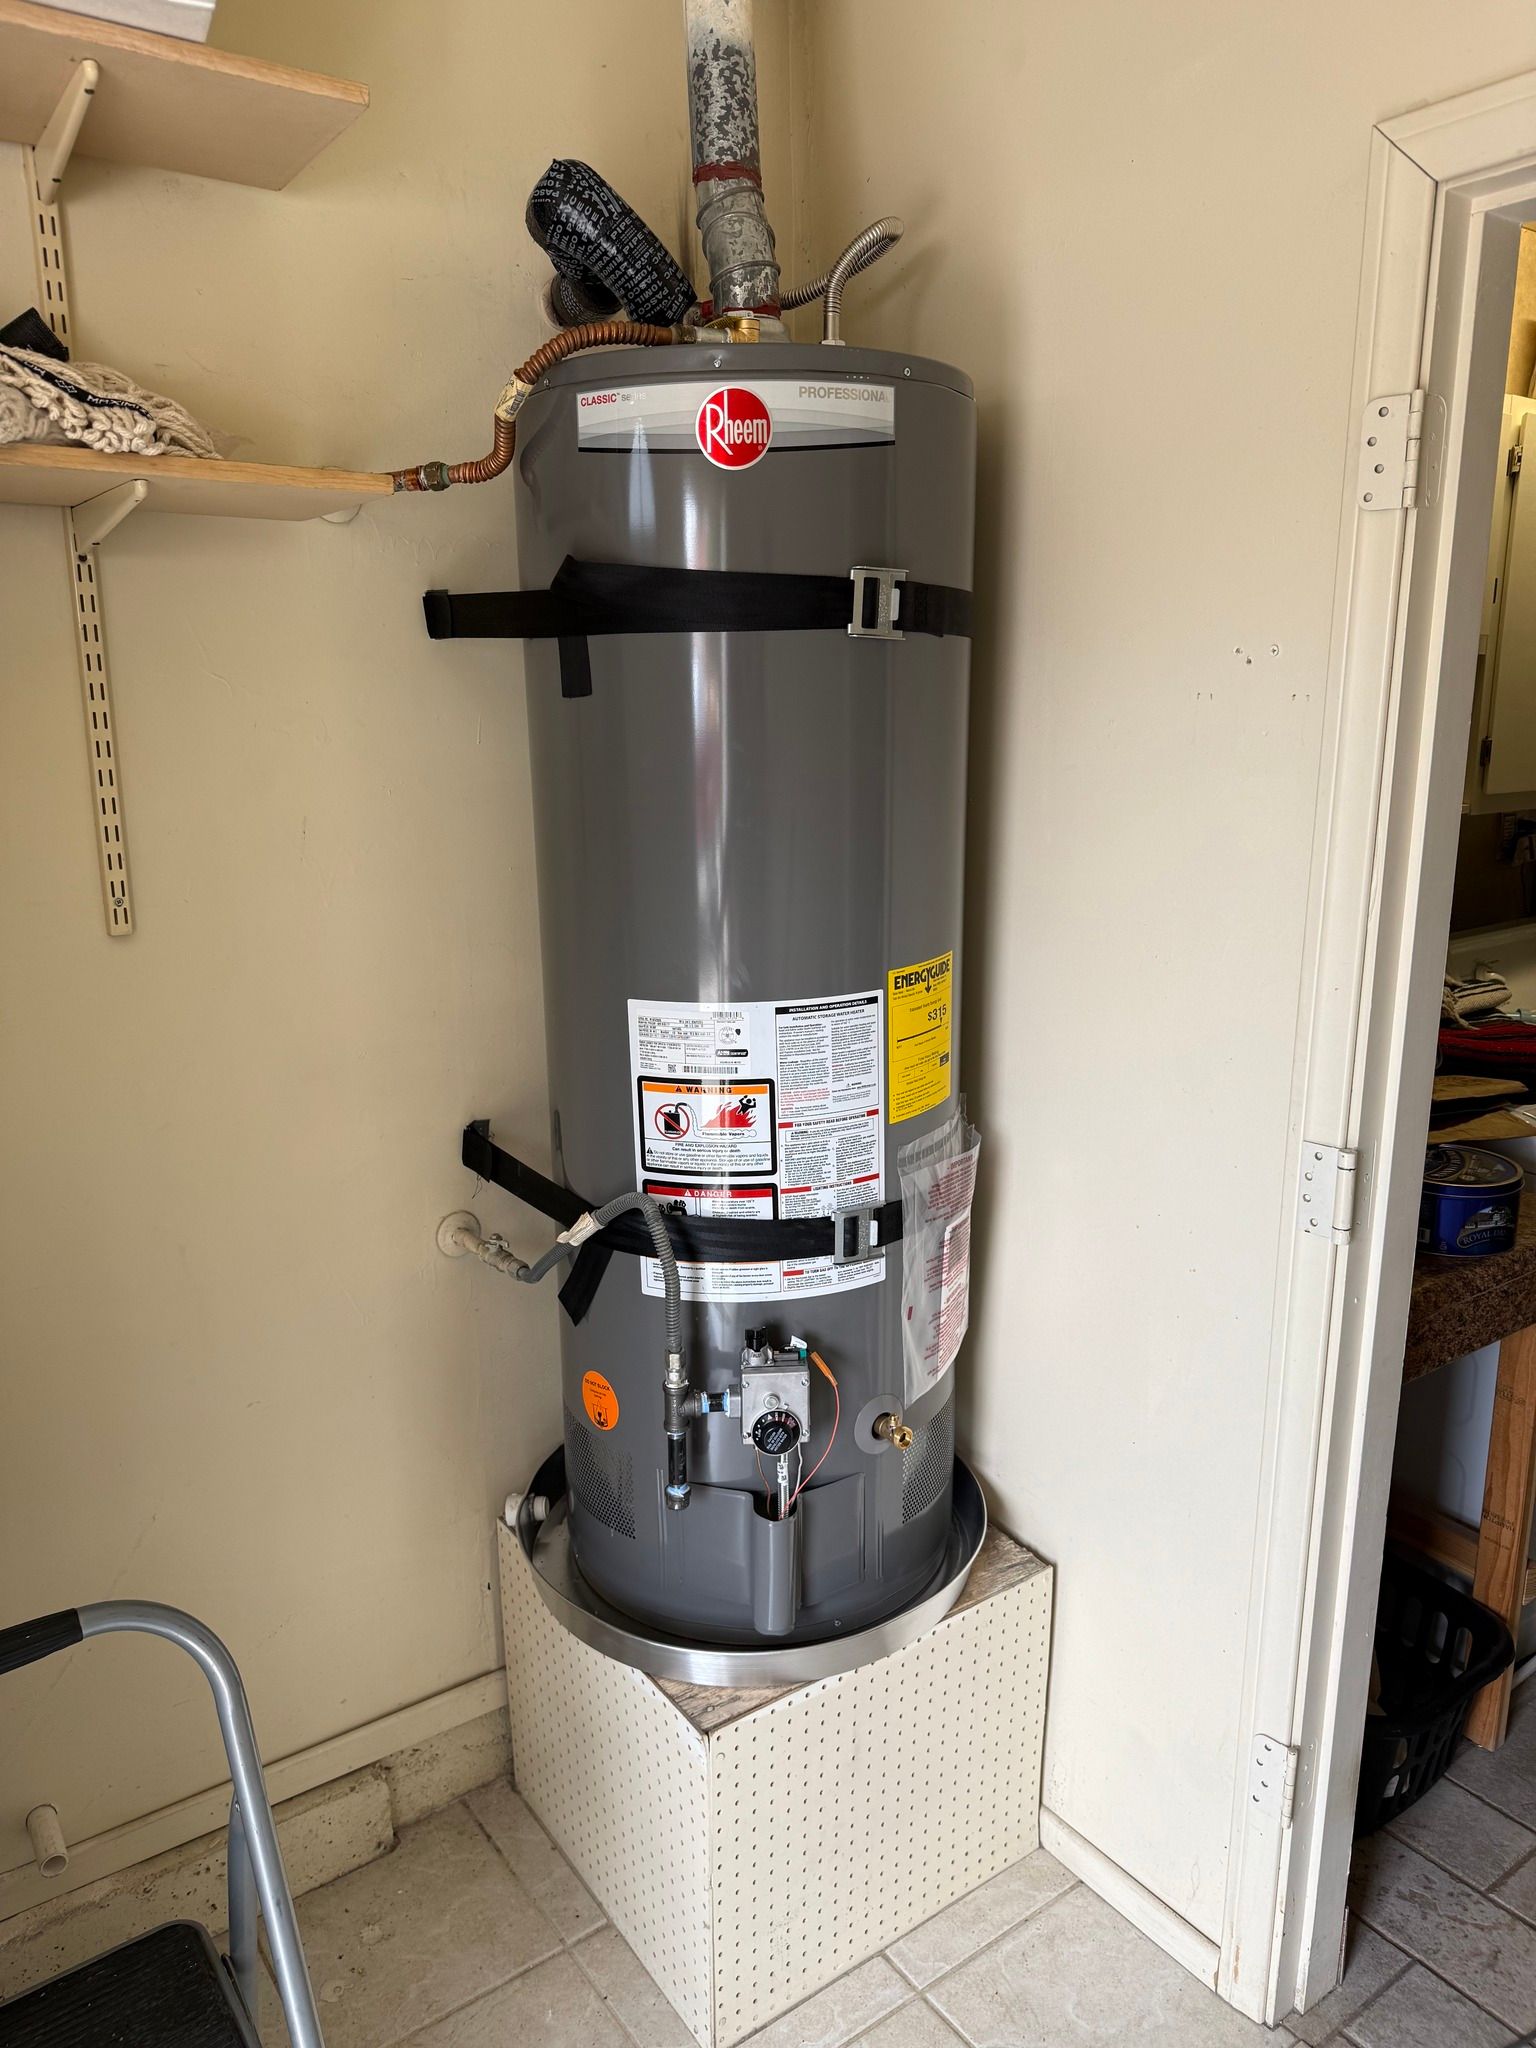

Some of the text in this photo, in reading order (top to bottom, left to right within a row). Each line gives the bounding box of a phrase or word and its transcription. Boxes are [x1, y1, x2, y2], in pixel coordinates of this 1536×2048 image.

[610, 217, 632, 240] PIPE
[623, 231, 644, 255] PIPE
[634, 280, 663, 304] 10MIL
[638, 286, 669, 315] PASCO
[706, 390, 768, 455] Rheem
[894, 959, 950, 990] ENERGYGUIDE
[927, 1004, 947, 1022] $315
